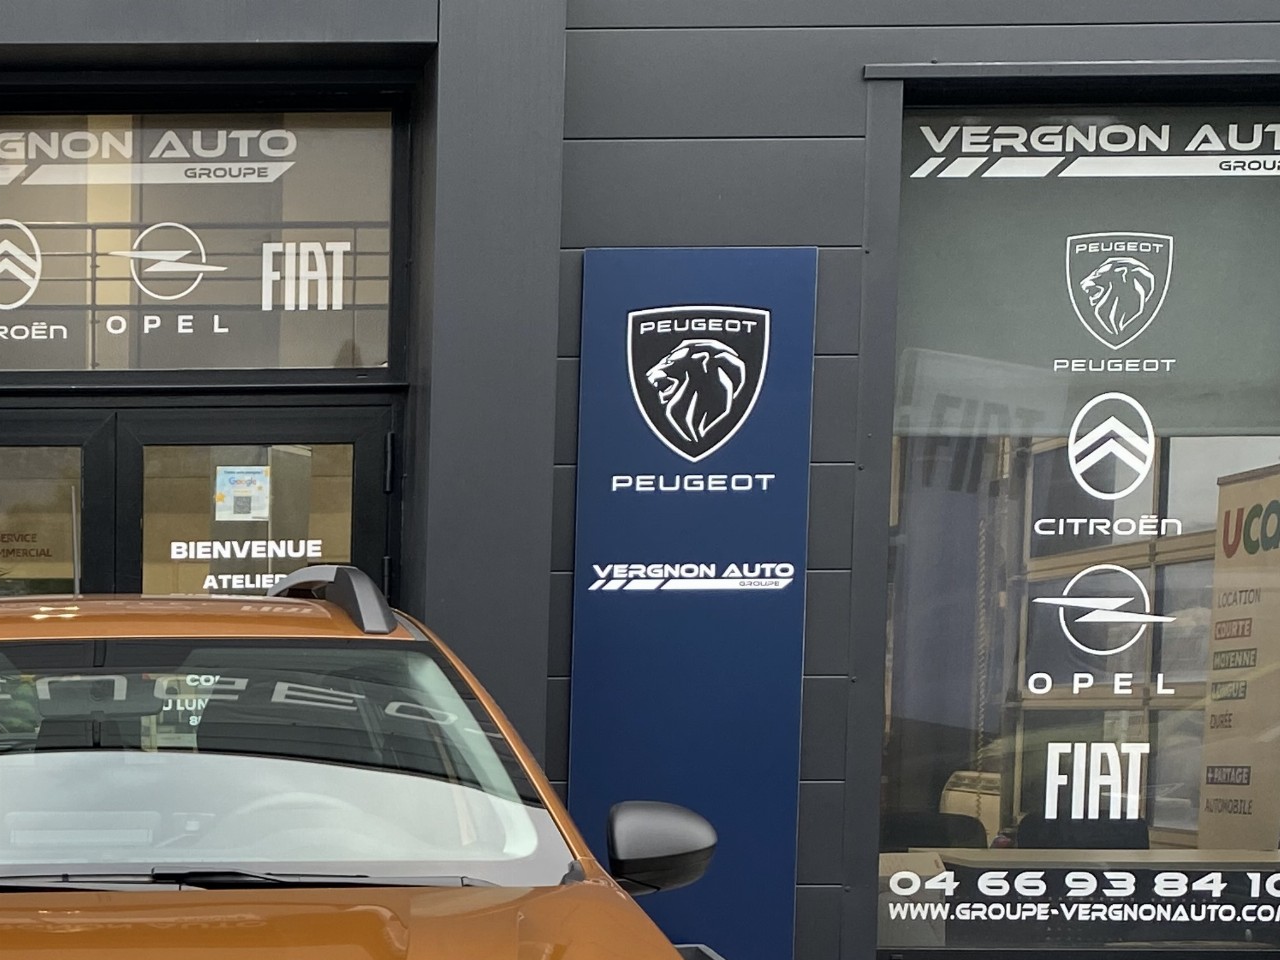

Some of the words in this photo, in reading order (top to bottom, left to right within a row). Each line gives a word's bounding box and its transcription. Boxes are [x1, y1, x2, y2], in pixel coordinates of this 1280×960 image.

[149, 128, 298, 159] AUTO
[919, 124, 1170, 154] VERGNON
[184, 166, 270, 180] GROUPE
[1219, 159, 1280, 171] GROU
[1075, 241, 1164, 254] PEUGEOT
[261, 241, 351, 311] FIAT
[106, 314, 229, 335] OPEL
[639, 318, 758, 335] PEUGEOT
[1053, 358, 1177, 373] PEUGEOT
[228, 477, 257, 487] Google
[612, 474, 776, 492] PEUGEOT
[1033, 514, 1183, 536] CITROËN
[170, 539, 323, 560] BIENVENUE
[592, 563, 717, 579] VERGNON
[721, 563, 795, 578] AUTO
[1217, 588, 1261, 609] LOCATION
[1028, 672, 1176, 695] OPEL
[1044, 742, 1150, 820] FIAT
[889, 870, 960, 897] 04
[977, 870, 1047, 897] 66
[1064, 870, 1136, 897] 93
[1153, 870, 1228, 897] 84
[888, 902, 1280, 922] WWW.GROUPE-VERGNONAUTO.CO
